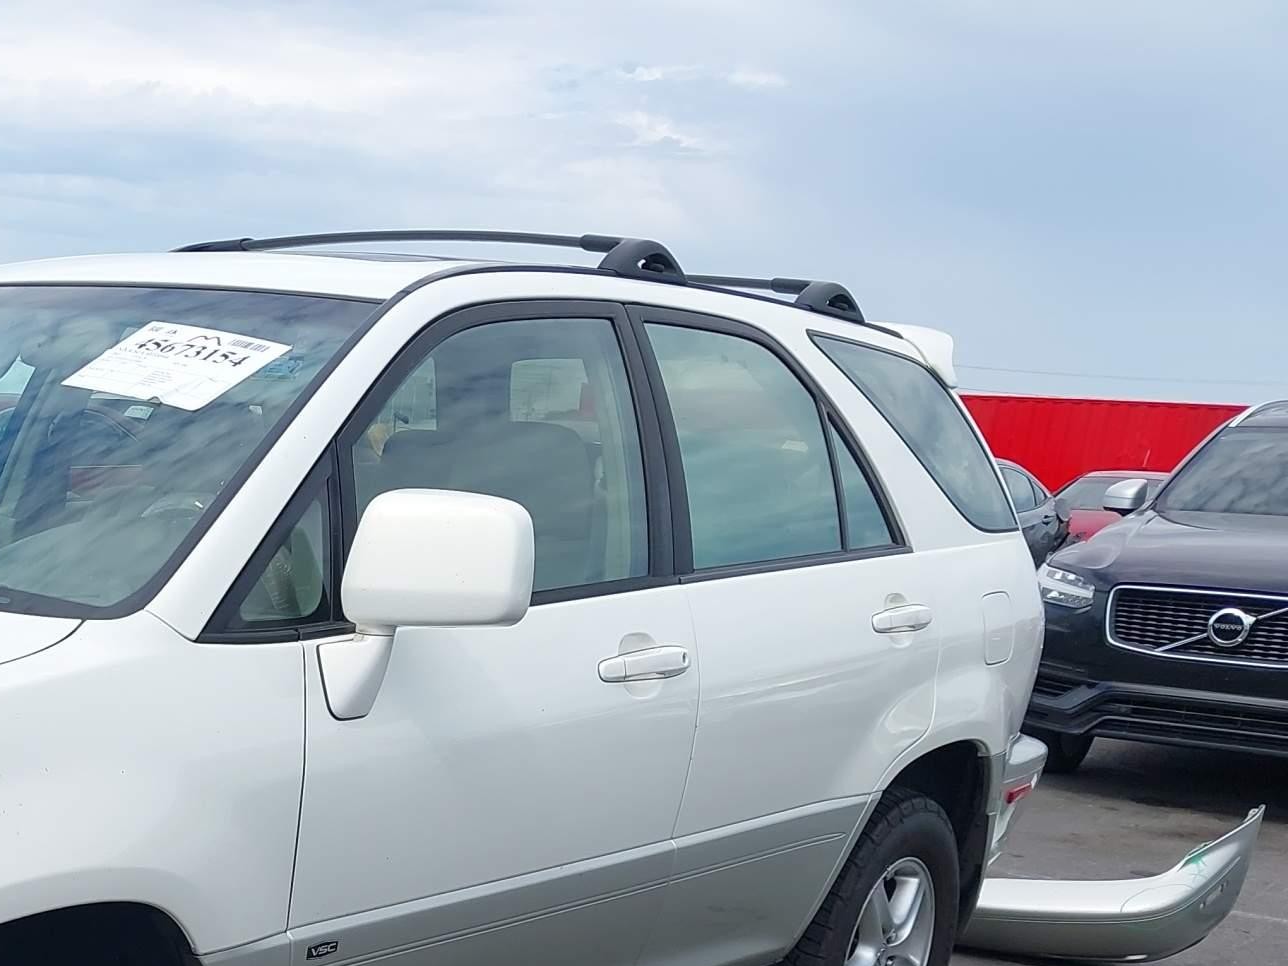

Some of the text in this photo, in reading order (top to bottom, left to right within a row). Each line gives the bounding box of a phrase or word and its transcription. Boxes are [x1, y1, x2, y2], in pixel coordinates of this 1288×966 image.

[135, 337, 251, 368] 45673154
[1213, 623, 1242, 631] VOLVO
[311, 942, 337, 957] VSC
